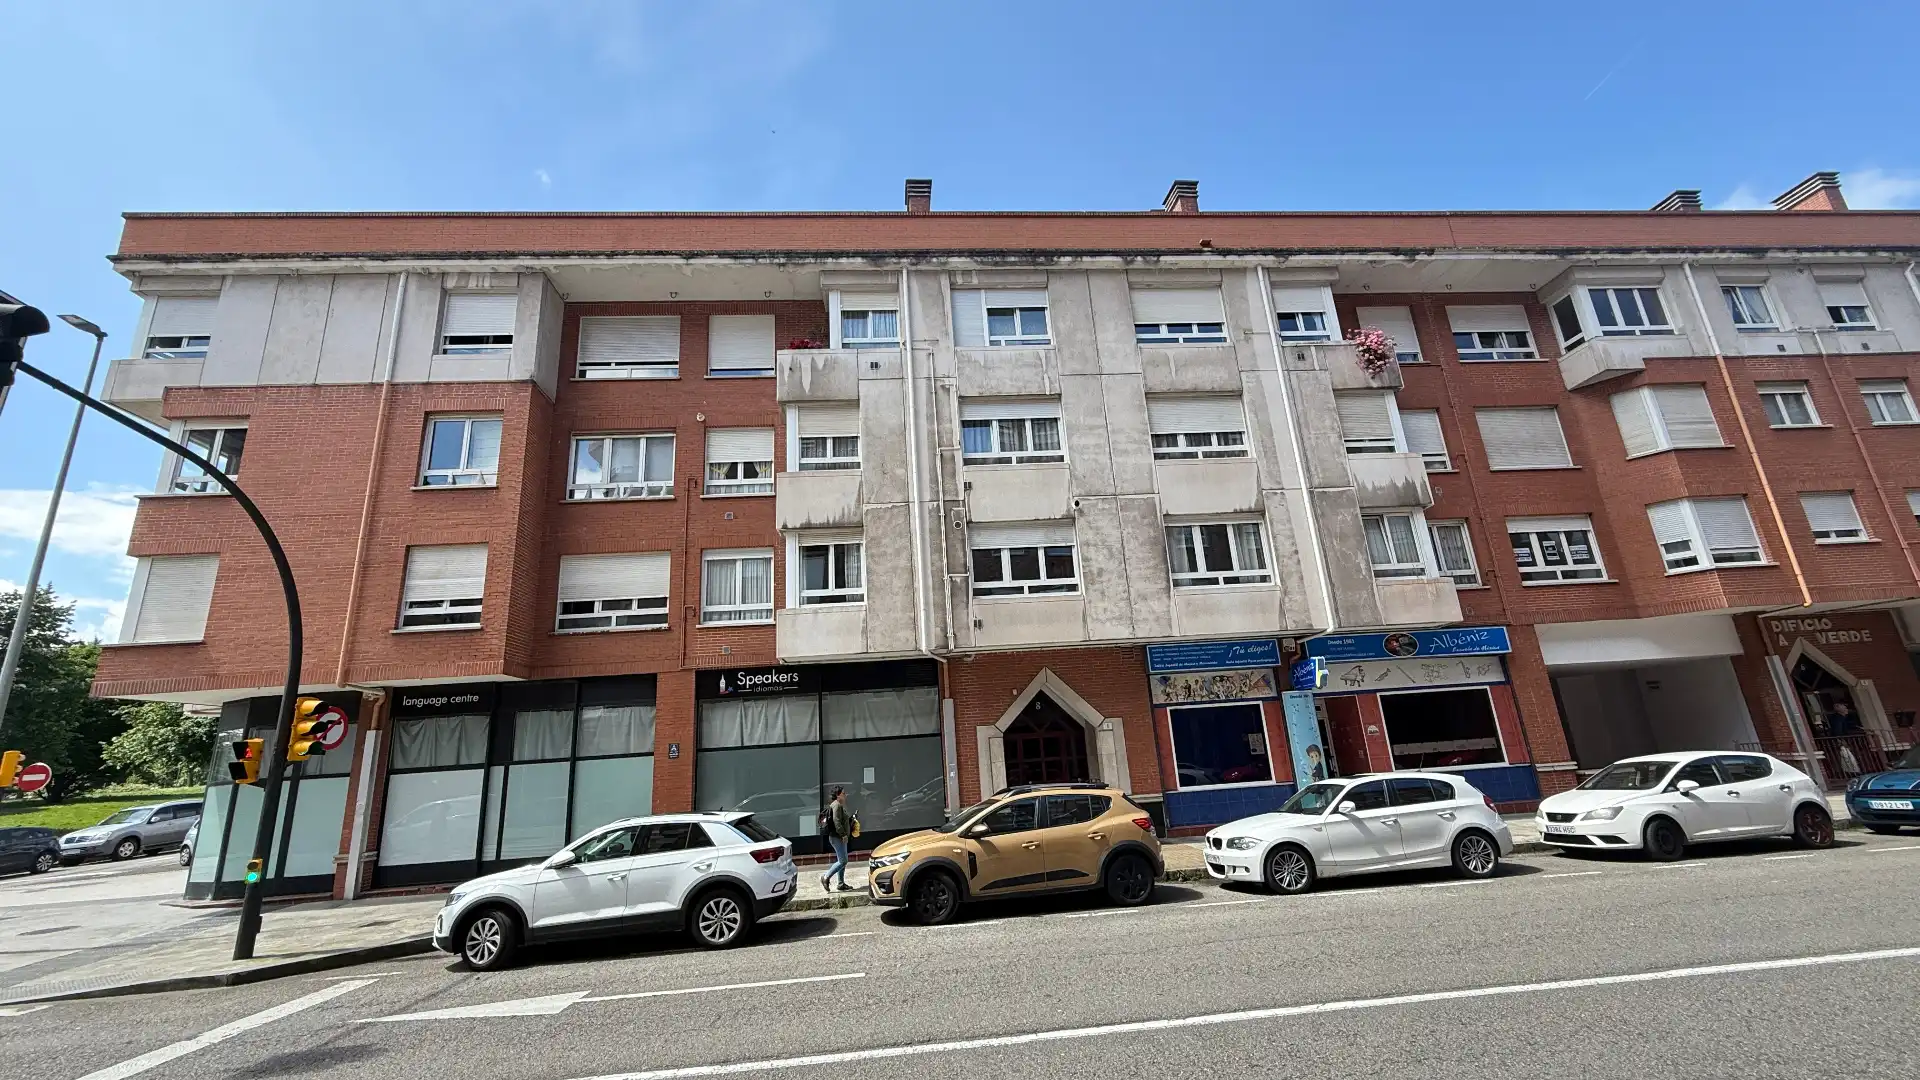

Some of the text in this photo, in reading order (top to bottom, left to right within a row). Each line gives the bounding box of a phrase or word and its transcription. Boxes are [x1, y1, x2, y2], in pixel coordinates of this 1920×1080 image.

[1771, 618, 1832, 632] DIFICIO
[1429, 630, 1491, 653] Albéniz
[1816, 630, 1872, 644] VERDE
[737, 669, 799, 688] Speakers
[402, 694, 479, 708] language centre
[1035, 701, 1041, 710] 8
